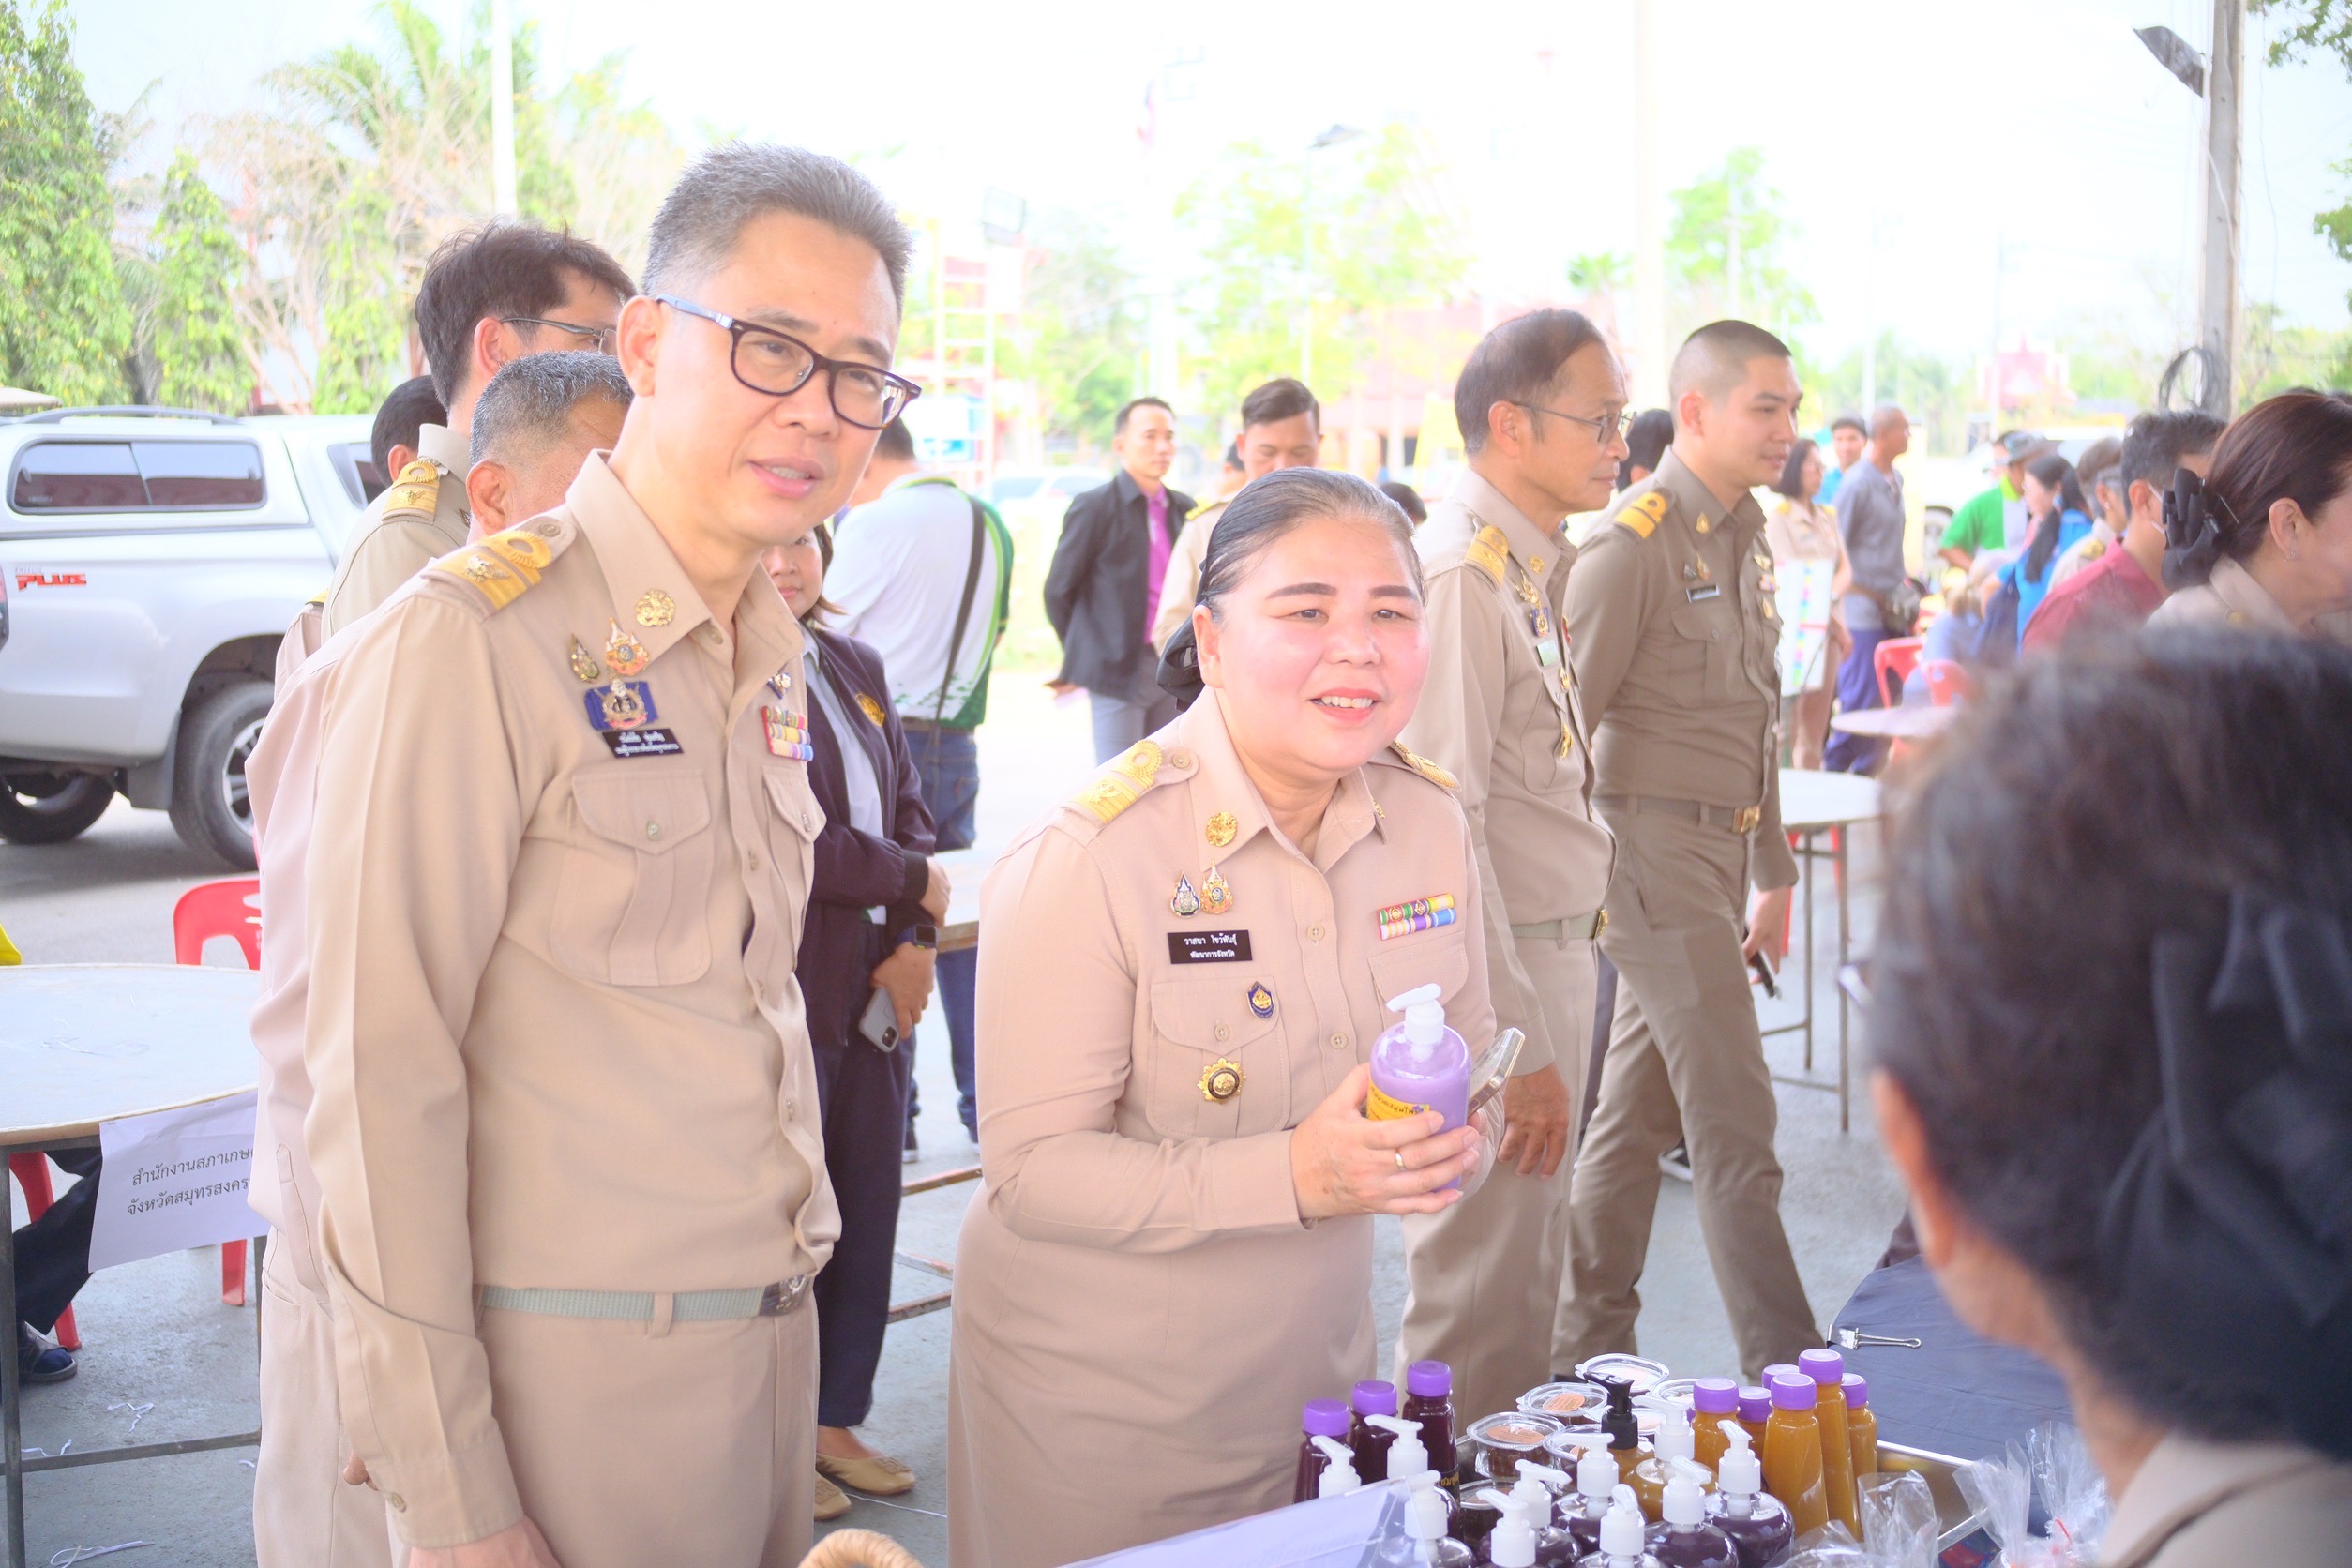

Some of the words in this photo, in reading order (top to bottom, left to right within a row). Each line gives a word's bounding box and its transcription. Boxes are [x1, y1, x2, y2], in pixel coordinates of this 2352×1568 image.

[15, 574, 87, 591] PLUS
[128, 1177, 250, 1216] จังหวัดสมุทรสงคร
